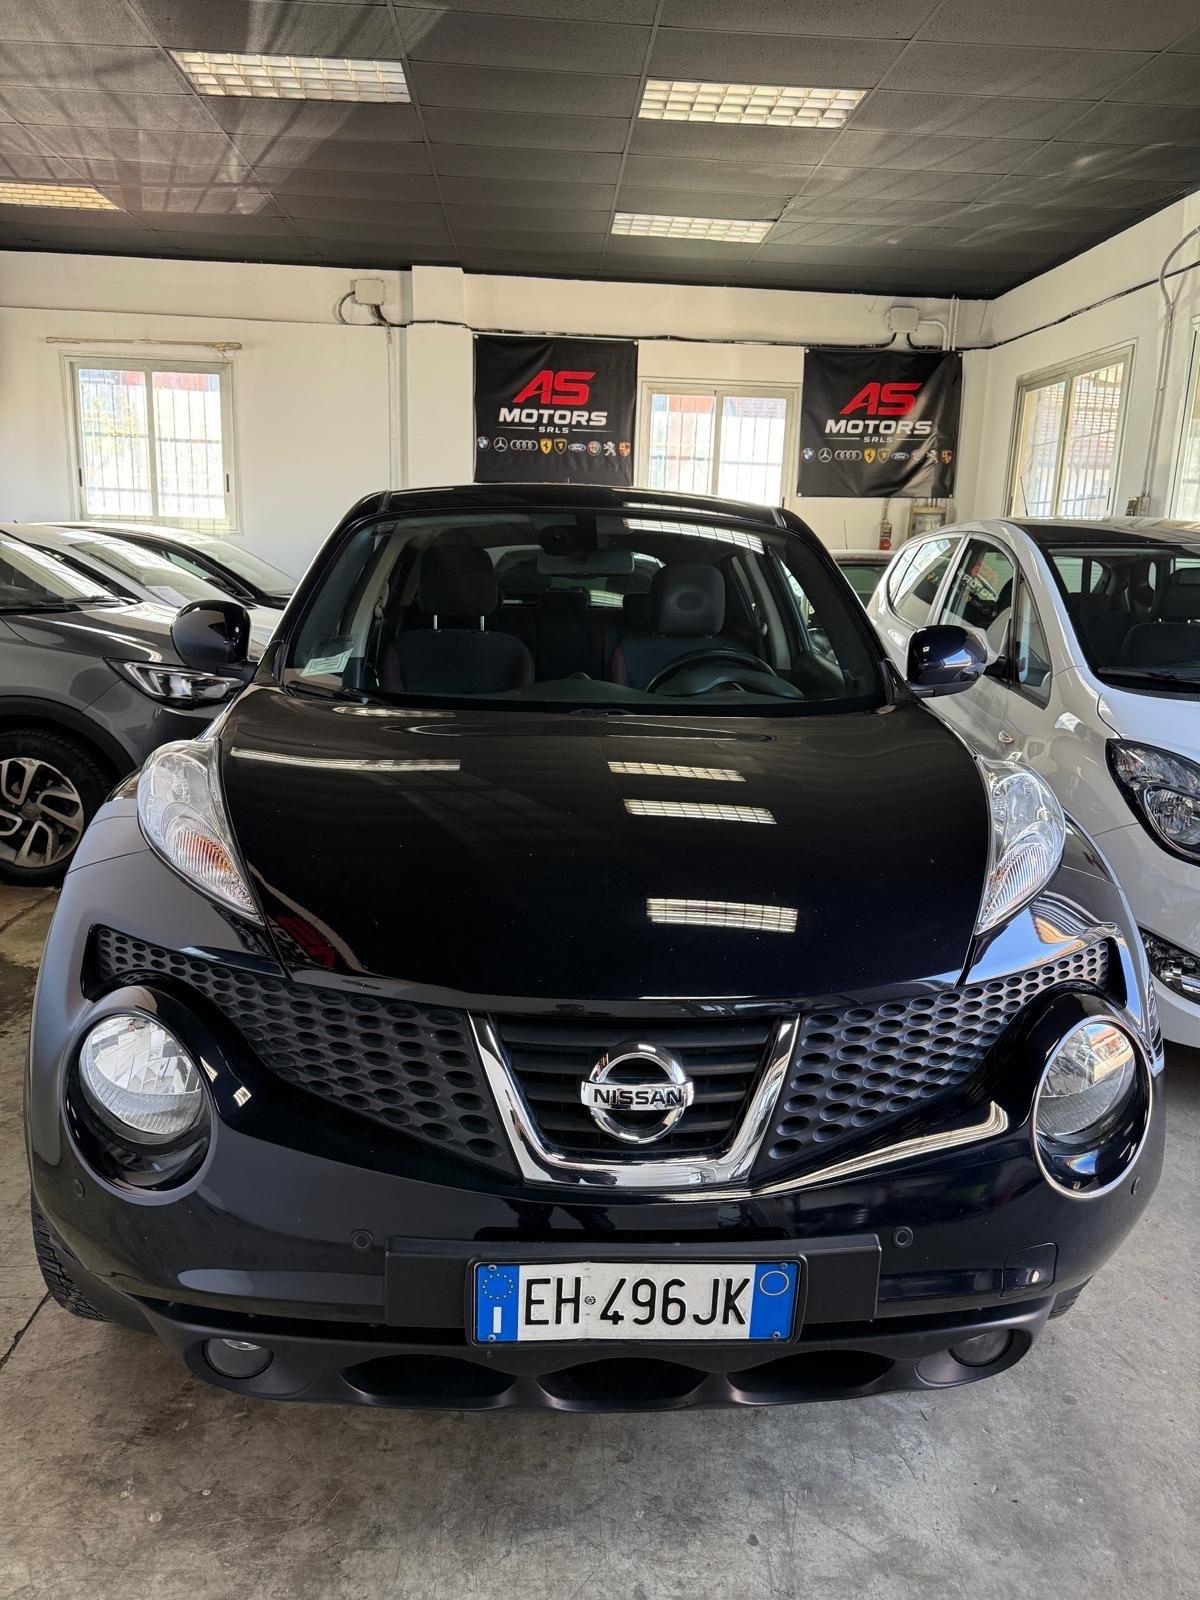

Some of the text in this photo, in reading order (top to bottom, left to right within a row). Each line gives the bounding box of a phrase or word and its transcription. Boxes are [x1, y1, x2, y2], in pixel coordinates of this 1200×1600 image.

[511, 370, 597, 406] AS
[839, 382, 924, 416] AS
[498, 407, 608, 426] MOTORS
[538, 426, 569, 434] SRLS
[824, 419, 933, 435] MOTORS
[593, 1088, 682, 1105] NISSAN
[525, 1276, 751, 1326] EH 496JK
